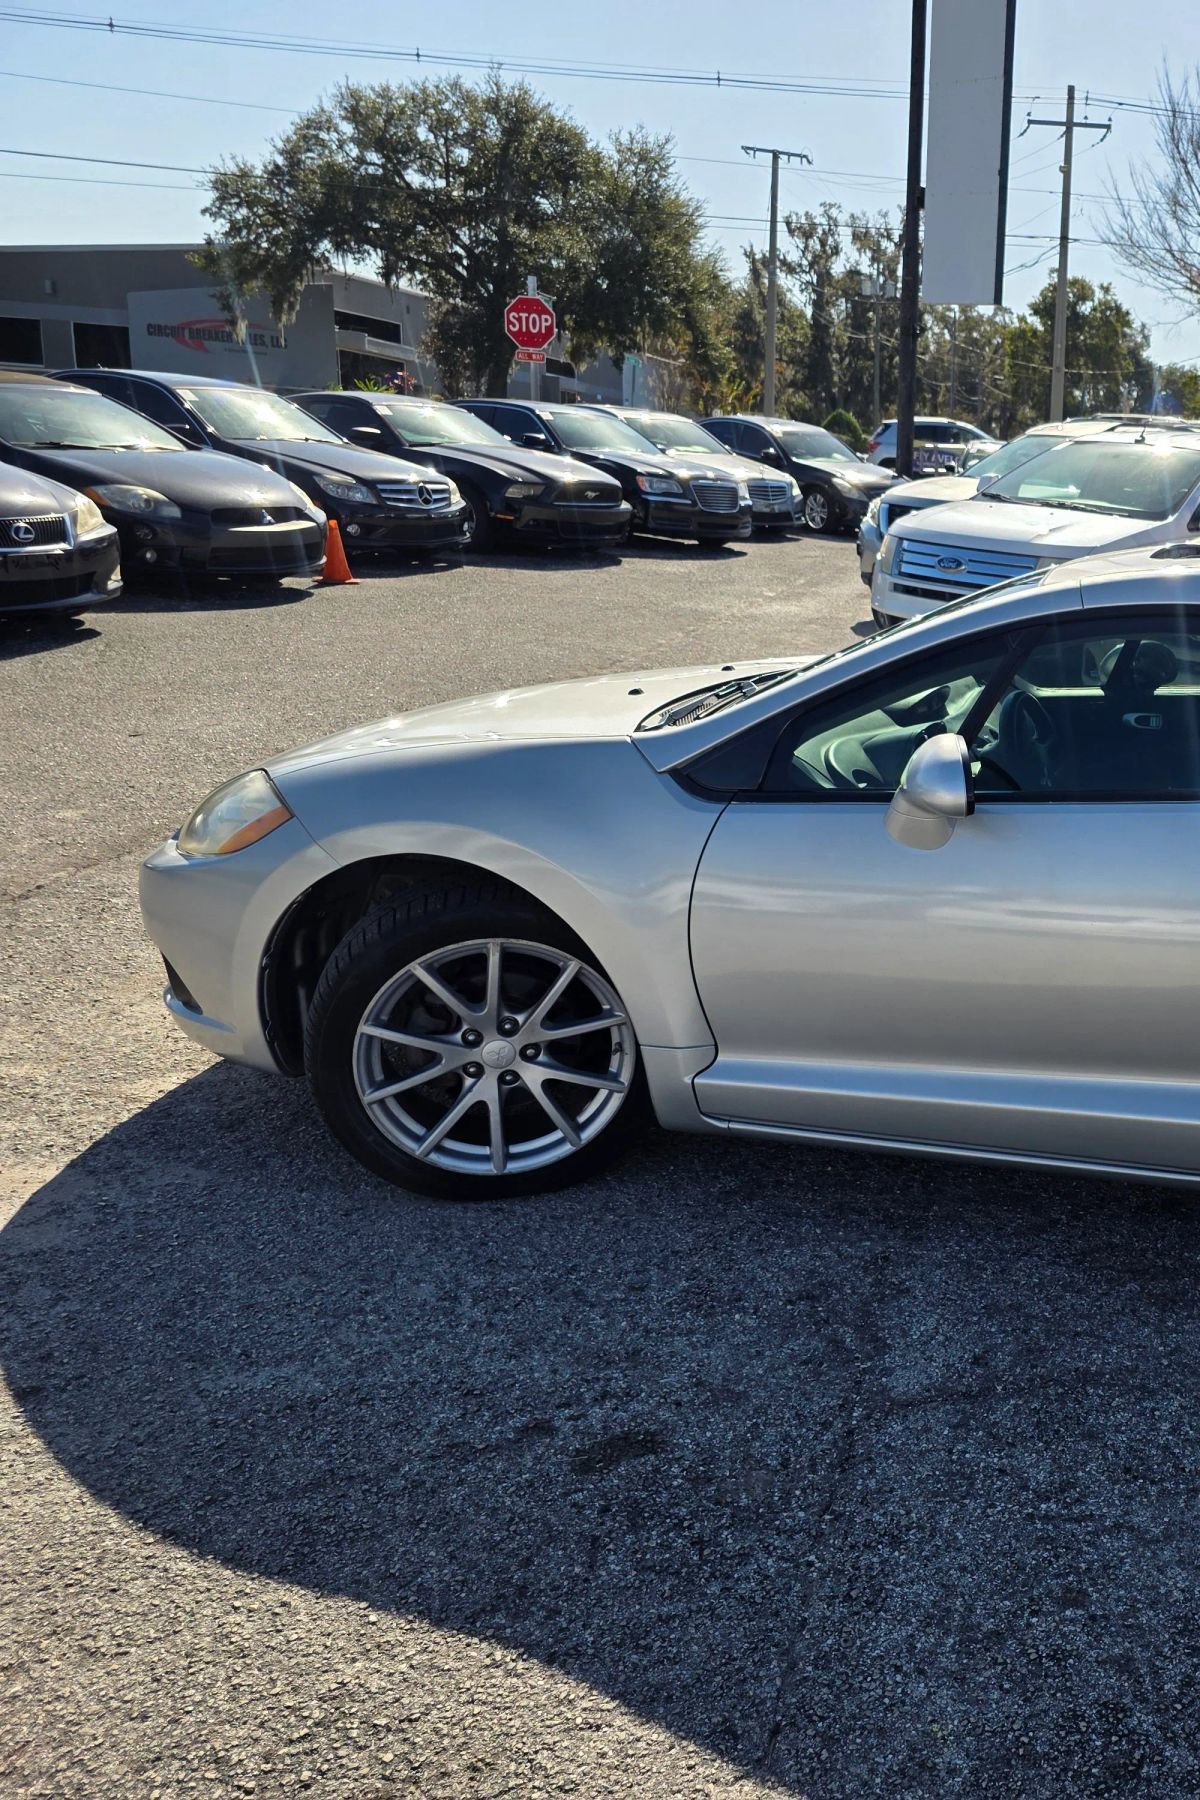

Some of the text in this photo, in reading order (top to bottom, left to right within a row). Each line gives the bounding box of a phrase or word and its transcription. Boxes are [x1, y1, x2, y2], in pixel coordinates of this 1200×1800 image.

[146, 323, 186, 338] CIRCUIT
[188, 327, 233, 343] BREAKER
[509, 312, 552, 334] STOP
